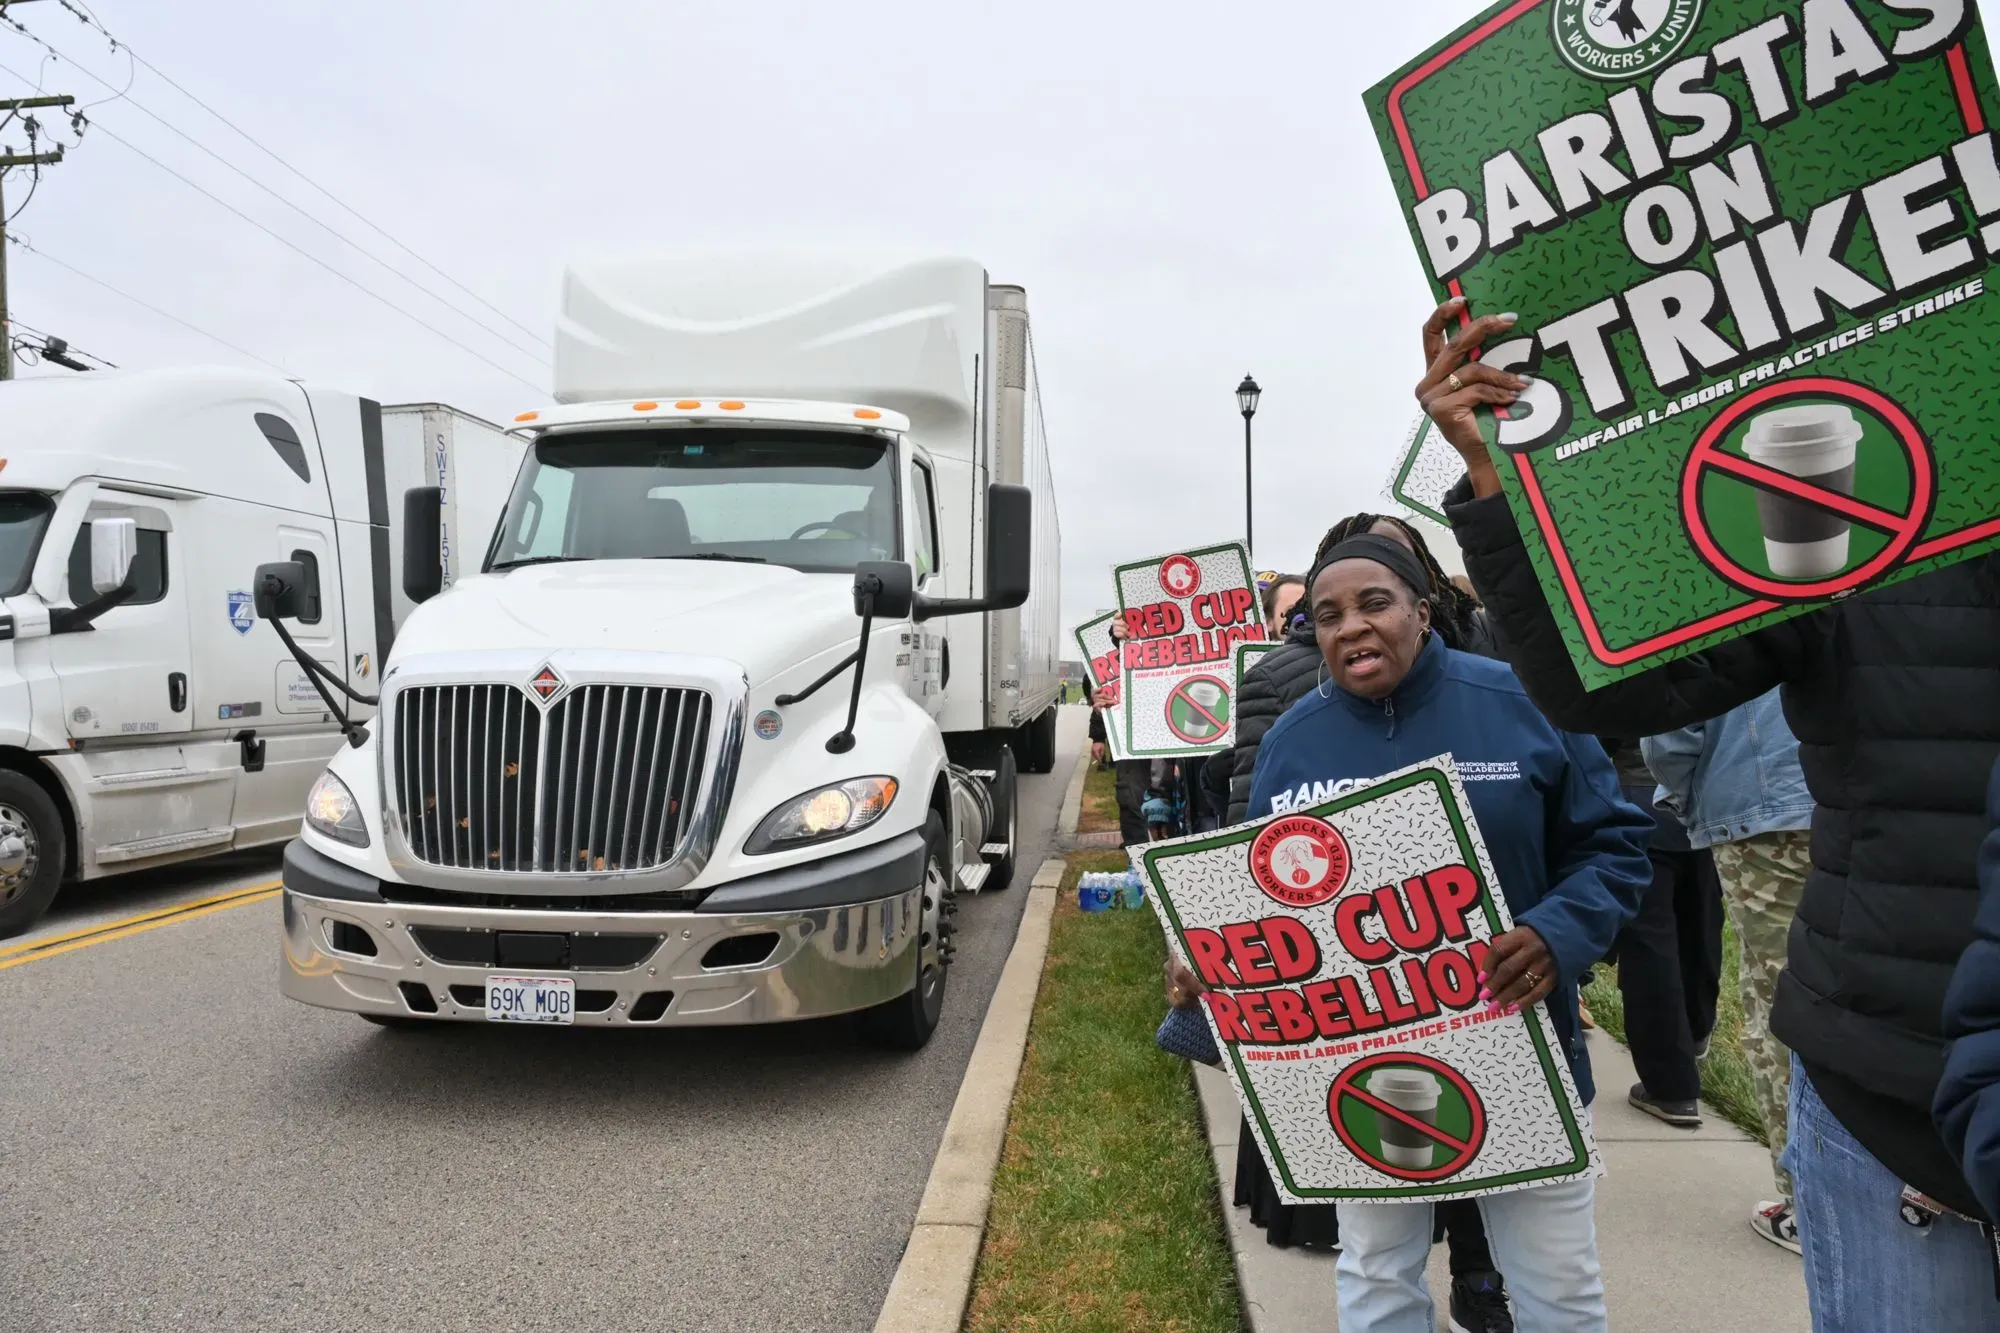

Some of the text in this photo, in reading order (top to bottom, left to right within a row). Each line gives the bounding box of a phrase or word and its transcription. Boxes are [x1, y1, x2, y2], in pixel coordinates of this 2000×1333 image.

[1567, 29, 1645, 69] WORKERS
[1413, 0, 1964, 278] BARISTAS
[1623, 143, 1776, 265] ON
[1479, 132, 2000, 445] STRIKE!
[1555, 277, 1985, 461] UNFAIR LABOR PRACTICE STRIKE
[1124, 587, 1254, 640] RED CUP
[1258, 822, 1328, 857] STARBUCKS
[1259, 843, 1343, 901] WORKERS UNITED
[1183, 864, 1483, 990] RED CUP
[490, 987, 570, 1014] 69K MOB
[1247, 1050, 1301, 1061] UNFAIR
[1303, 1041, 1359, 1059] LABOR
[1361, 1021, 1447, 1051] PRACTICE
